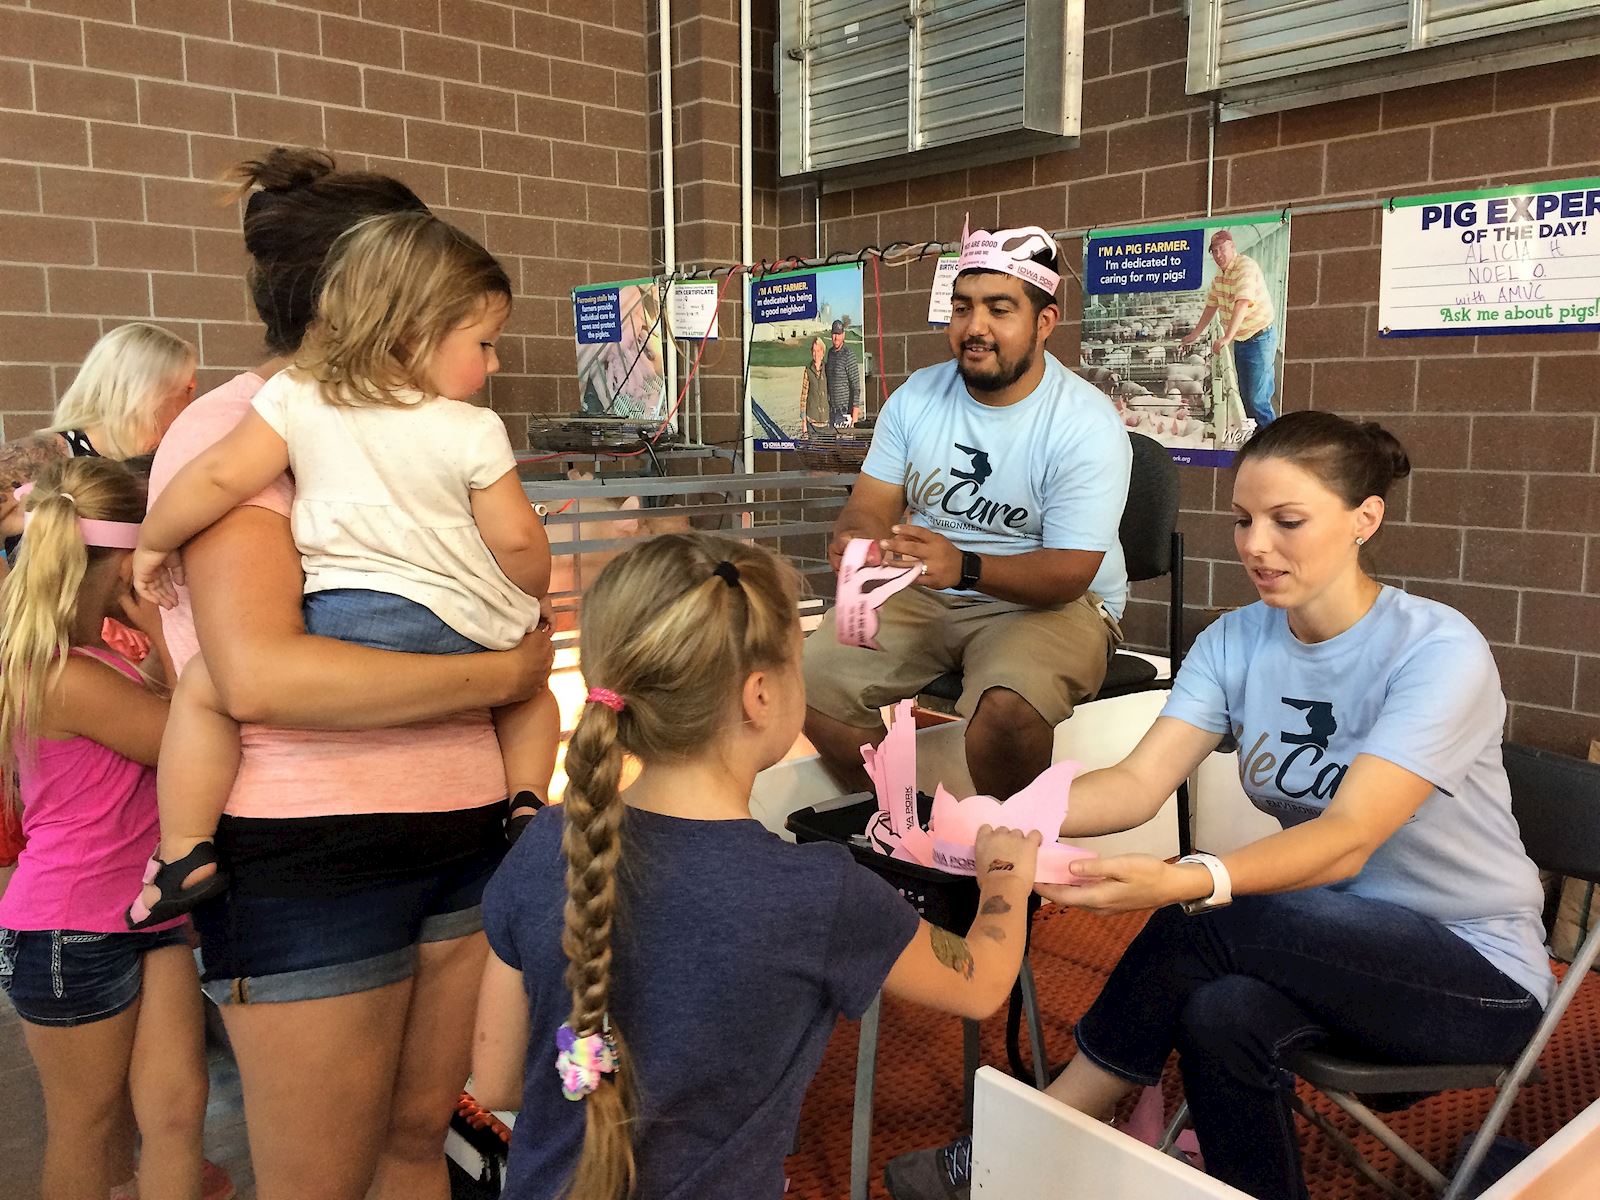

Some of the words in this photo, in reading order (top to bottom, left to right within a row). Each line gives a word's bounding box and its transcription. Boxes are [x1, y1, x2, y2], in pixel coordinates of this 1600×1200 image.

[1422, 202, 1477, 230] PIG
[1487, 190, 1600, 224] EXPER
[1461, 230, 1488, 244] OF
[1493, 225, 1533, 242] THE
[1539, 221, 1587, 238] DAY!
[981, 240, 998, 248] GOOD
[1098, 246, 1113, 257] I'M
[1115, 245, 1123, 256] A
[1125, 243, 1142, 255] PIG
[1144, 240, 1190, 254] FARMER.
[1465, 241, 1530, 264] ALICIA
[1105, 259, 1119, 270] I'm
[1121, 255, 1168, 269] dedicated
[1170, 256, 1181, 266] to
[1017, 265, 1038, 280] IOWA
[1039, 276, 1054, 288] PORK
[1100, 273, 1127, 286] caring
[1130, 271, 1143, 282] for
[1145, 271, 1160, 284] my
[1162, 268, 1186, 283] pigs!
[1469, 265, 1519, 284] NOEL
[767, 286, 772, 295] A
[783, 281, 809, 292] FARMER.
[1456, 291, 1486, 305] with
[1498, 282, 1545, 303] AMVC
[763, 295, 788, 306] dedicated
[790, 294, 796, 303] to
[796, 293, 812, 302] being
[765, 306, 779, 318] good
[1440, 308, 1471, 322] Ask
[1477, 309, 1499, 320] me
[1505, 304, 1553, 320] about
[1559, 298, 1600, 323] pigs!
[1172, 455, 1191, 463] ork.org
[904, 462, 945, 506] We
[941, 480, 1028, 529] Care
[1275, 744, 1349, 799] Ca
[949, 855, 976, 870] POR
